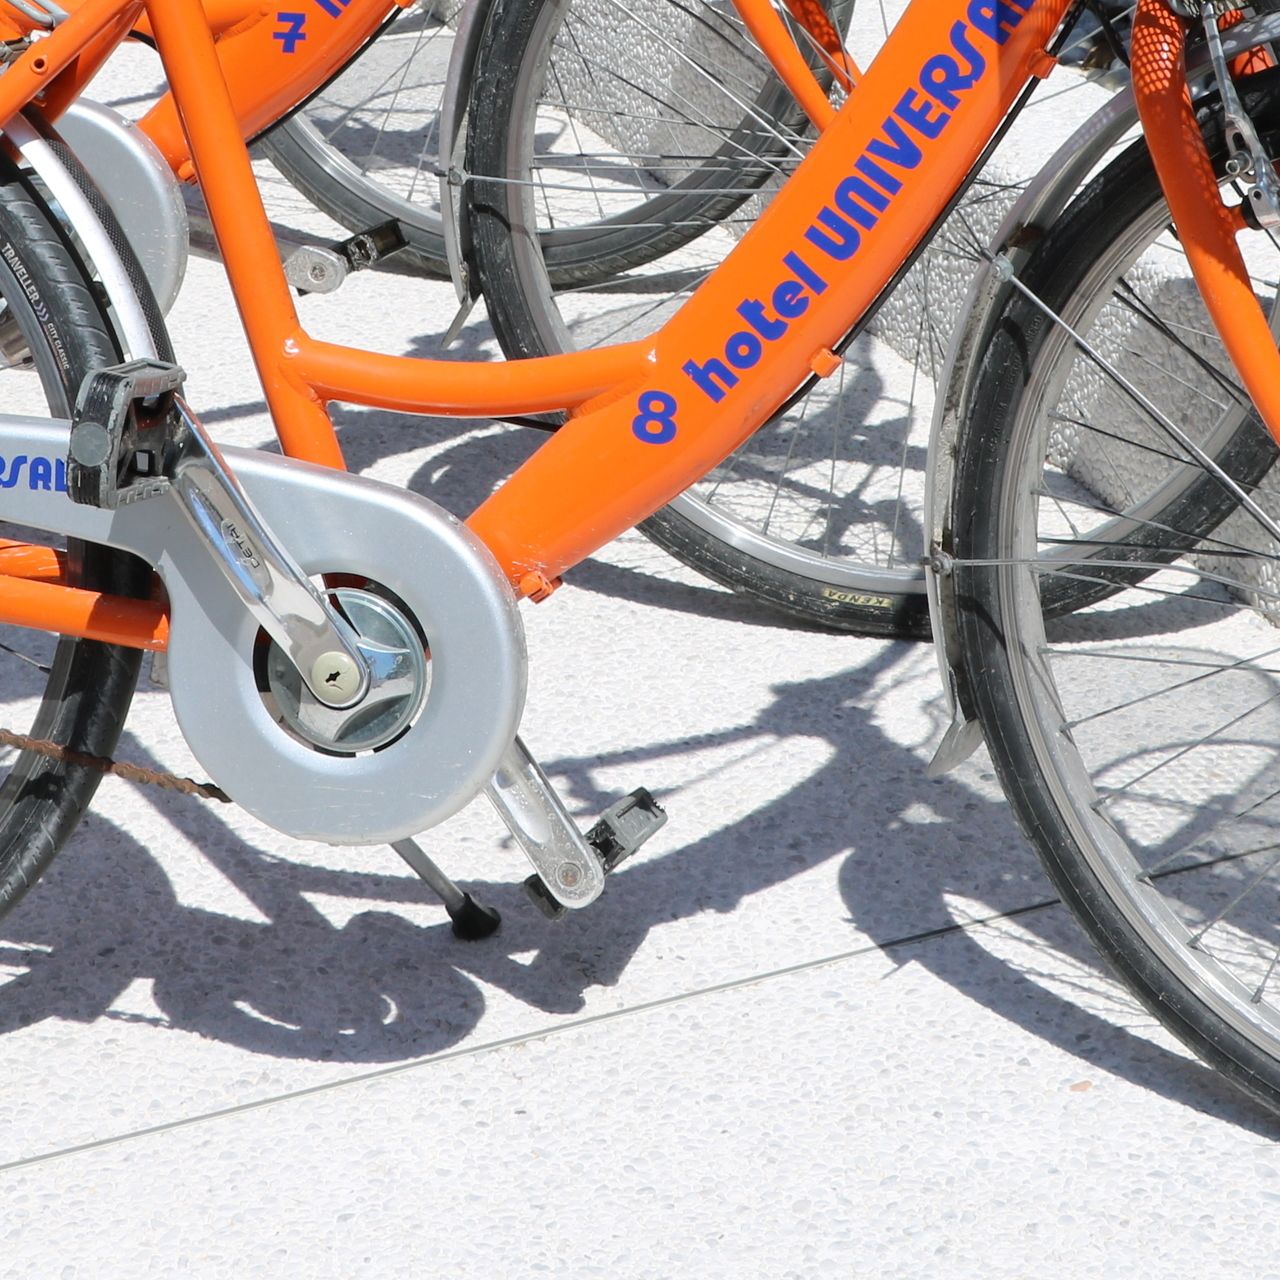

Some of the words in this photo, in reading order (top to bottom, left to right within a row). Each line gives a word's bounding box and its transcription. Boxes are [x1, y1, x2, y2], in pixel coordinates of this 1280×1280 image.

[273, 12, 307, 53] 7
[47, 322, 59, 339] CITY
[54, 339, 70, 370] CLASSIC
[632, 390, 678, 446] 8
[682, 250, 827, 403] hotel
[827, 589, 886, 606] KENDA
